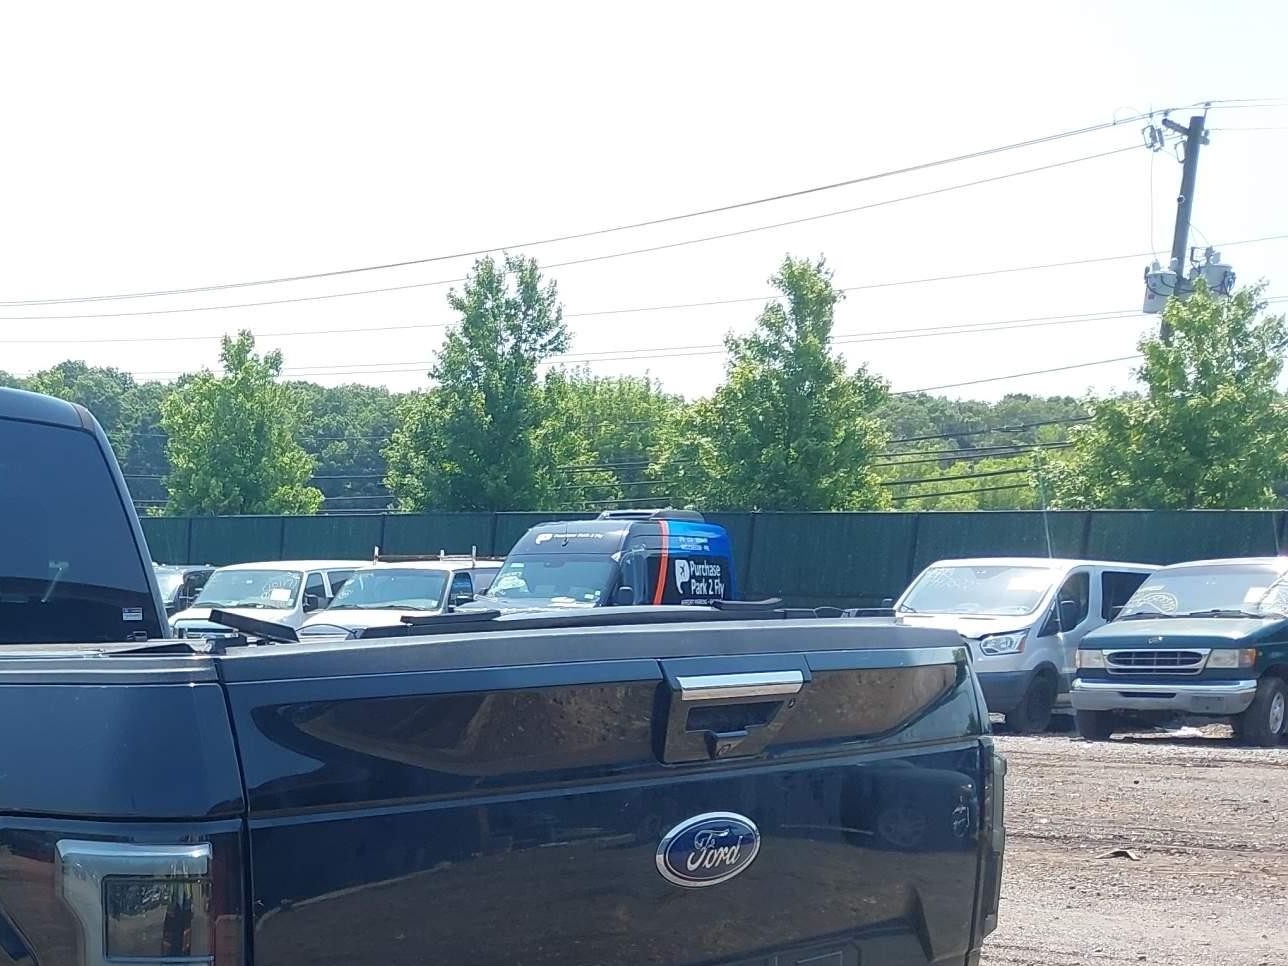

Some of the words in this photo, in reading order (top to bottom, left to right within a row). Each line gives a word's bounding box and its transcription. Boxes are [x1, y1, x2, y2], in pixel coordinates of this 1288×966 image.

[690, 560, 721, 577] Purchase
[691, 578, 707, 595] Park
[708, 579, 714, 595] 2
[714, 578, 725, 598] Fly
